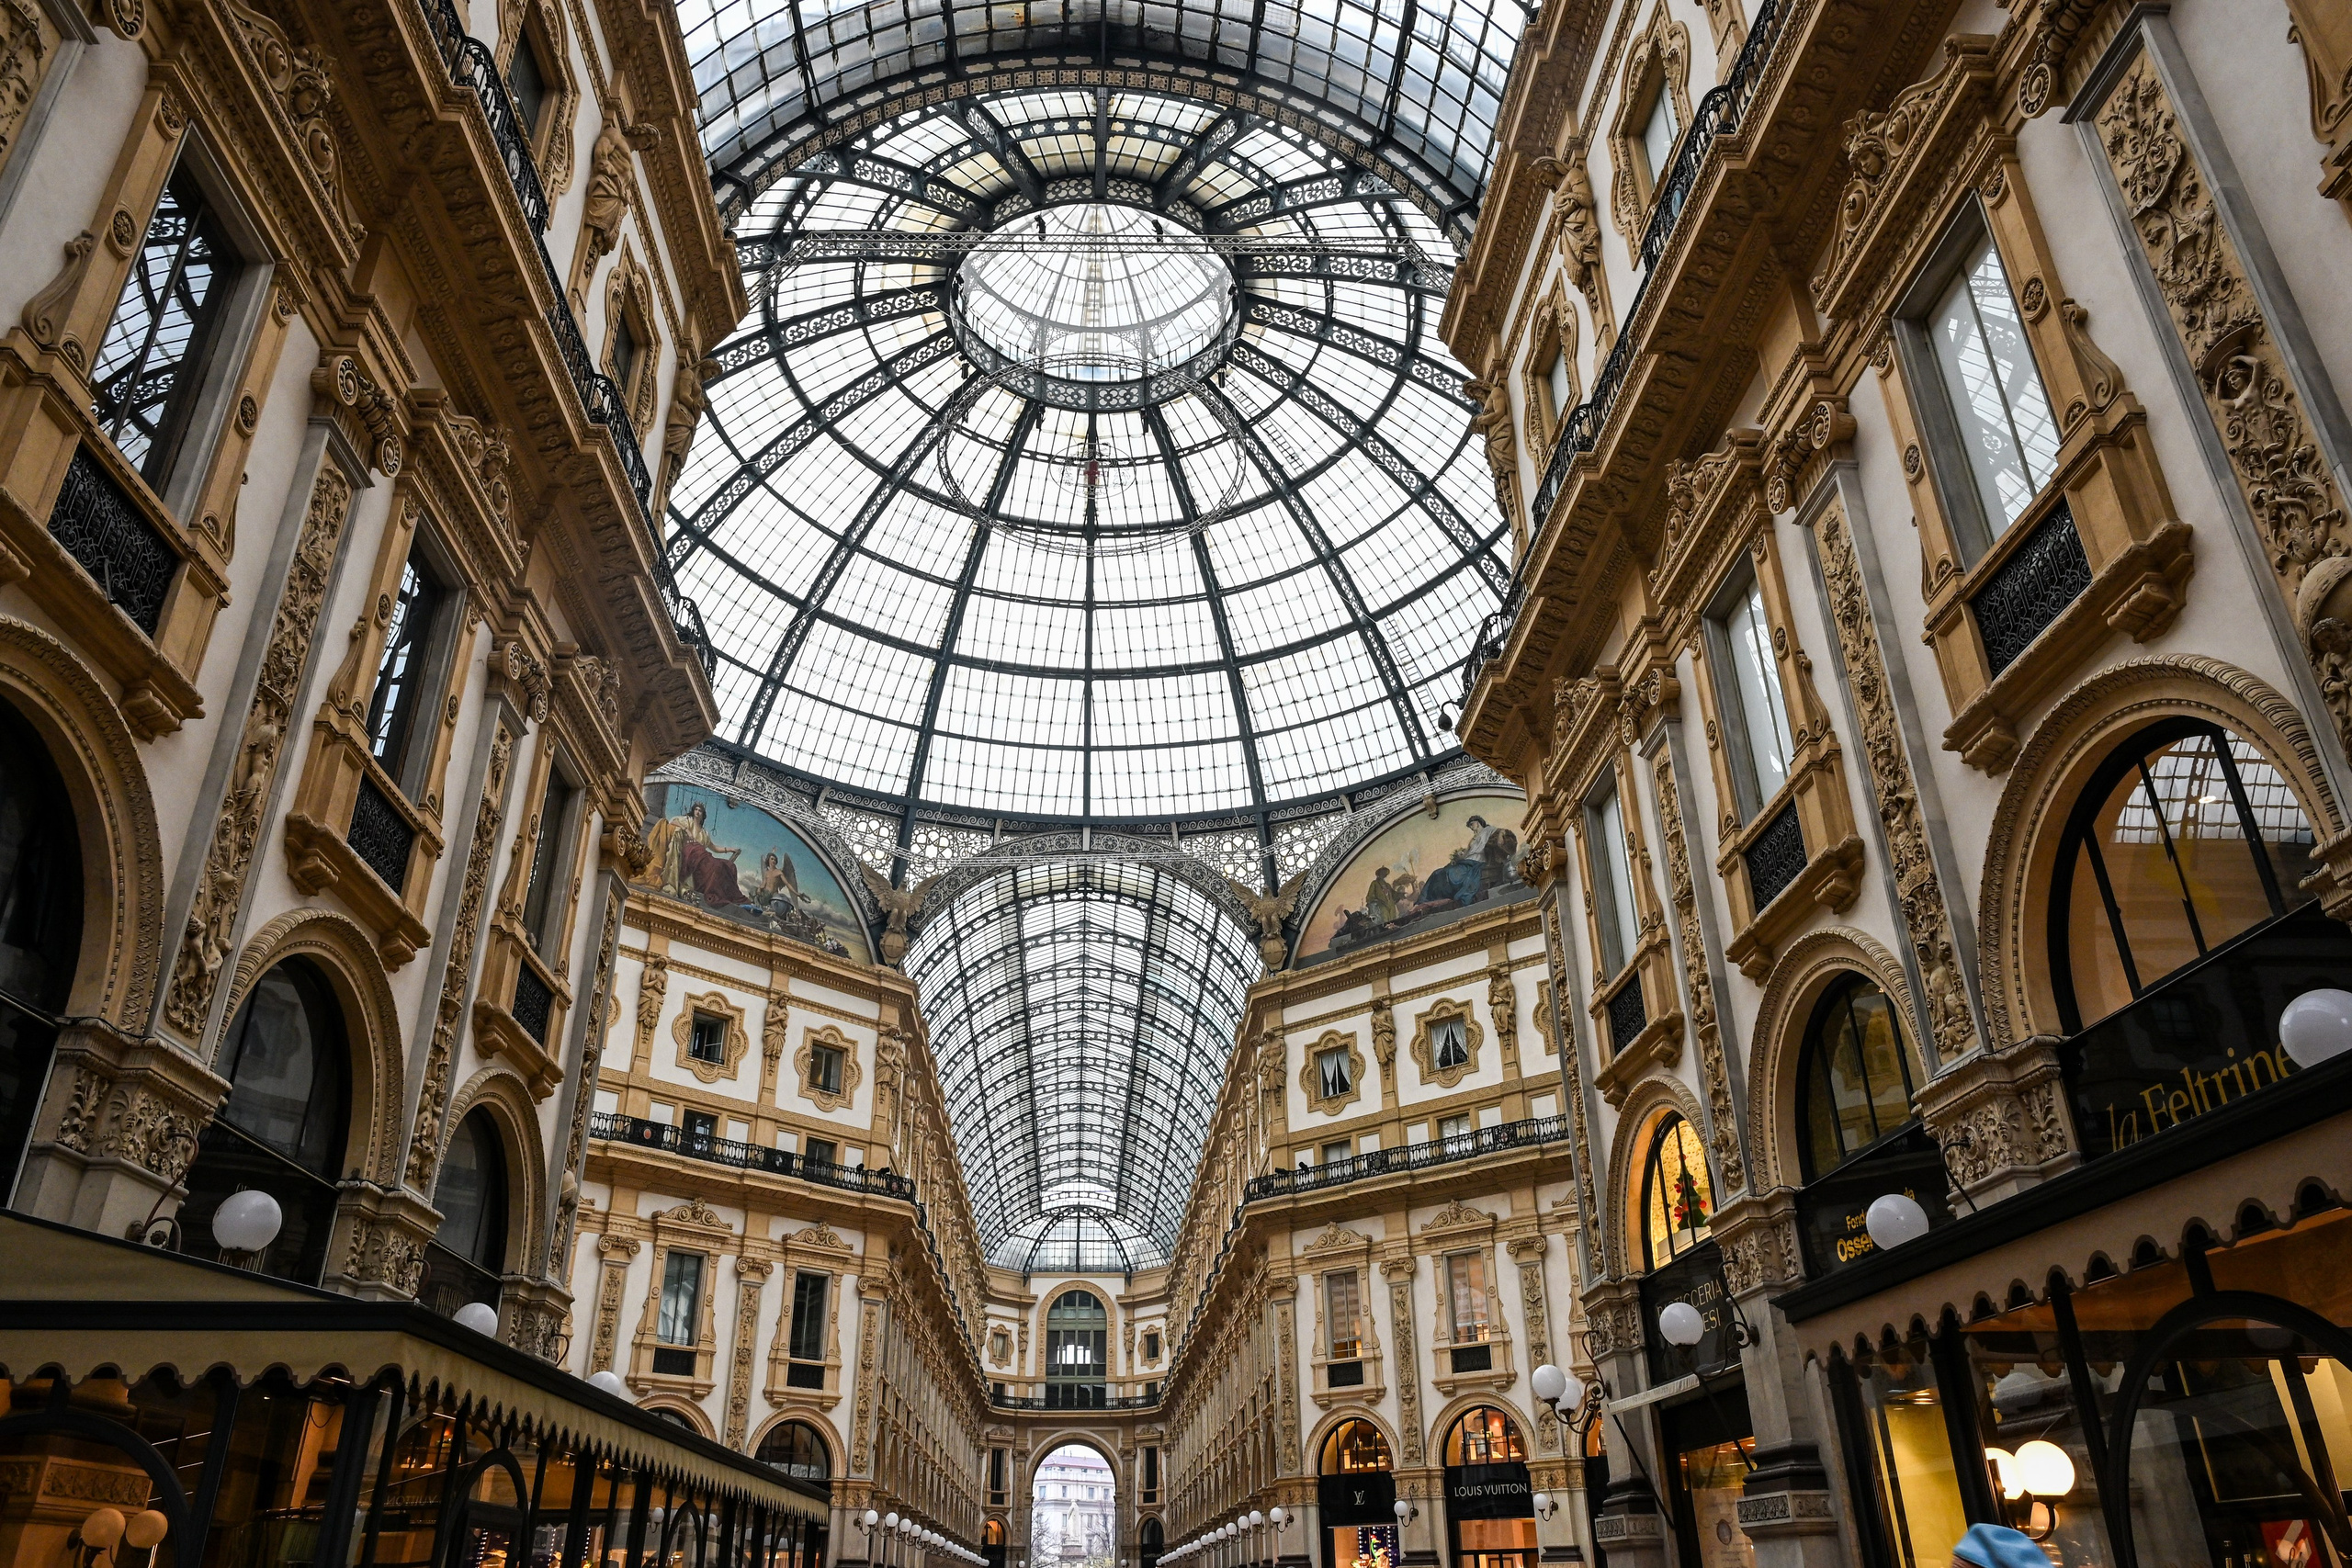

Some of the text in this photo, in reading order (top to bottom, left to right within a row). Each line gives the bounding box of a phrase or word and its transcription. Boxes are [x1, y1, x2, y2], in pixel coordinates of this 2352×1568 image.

[2106, 1102, 2143, 1152] la
[1845, 1208, 1867, 1231] Fond
[1454, 1483, 1528, 1497] LOUIS VUITTON
